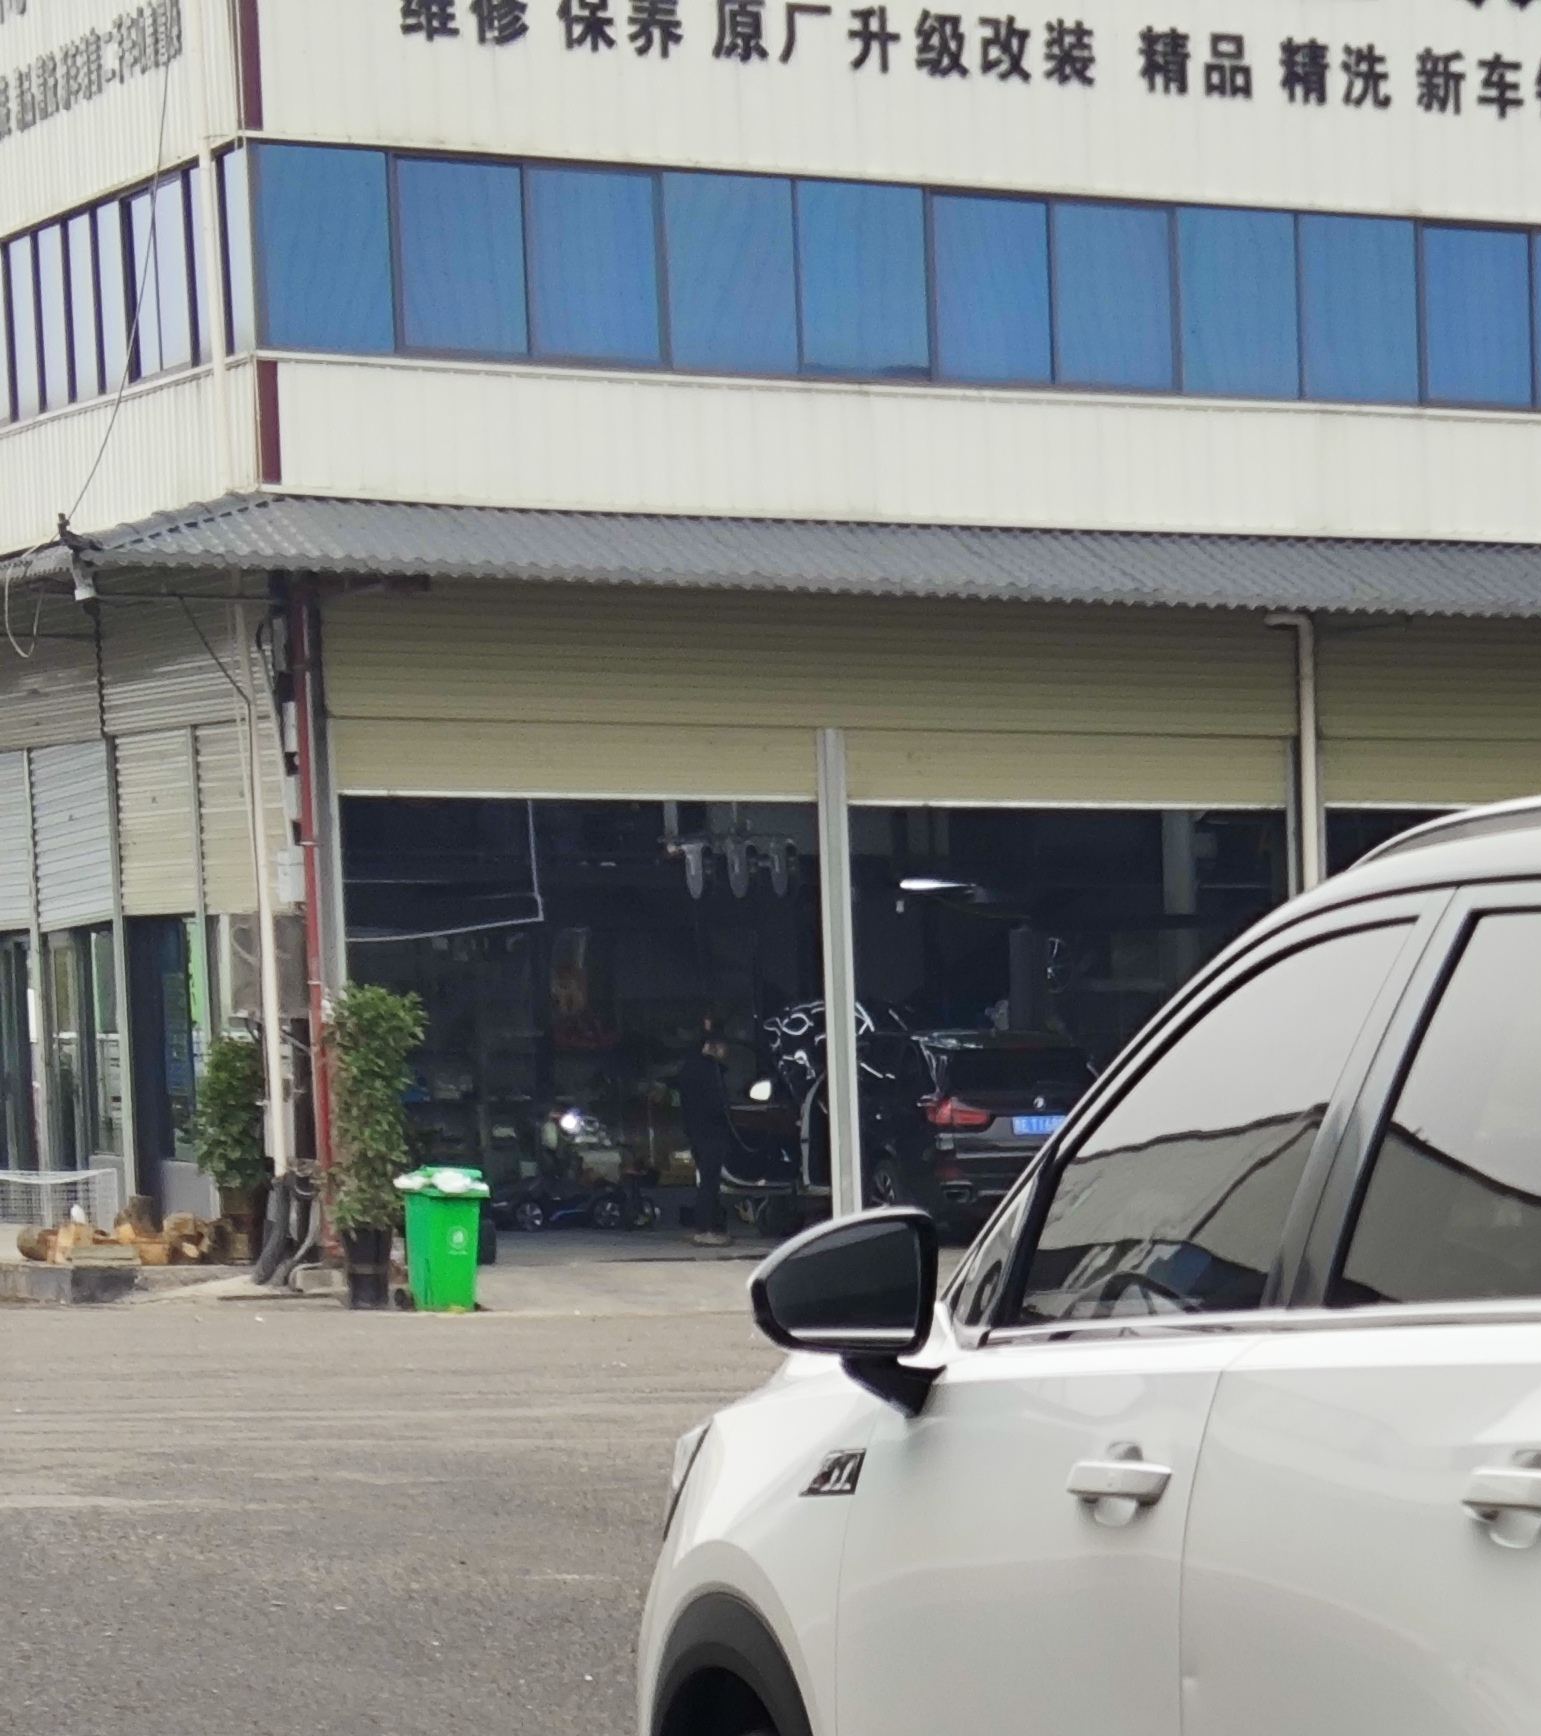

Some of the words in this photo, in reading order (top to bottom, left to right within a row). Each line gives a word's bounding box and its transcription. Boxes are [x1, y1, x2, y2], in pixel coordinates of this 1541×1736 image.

[400, 0, 530, 46] 维修
[556, 0, 684, 59] 保养
[1138, 25, 1253, 100] 精品
[1279, 36, 1392, 110] 精洗
